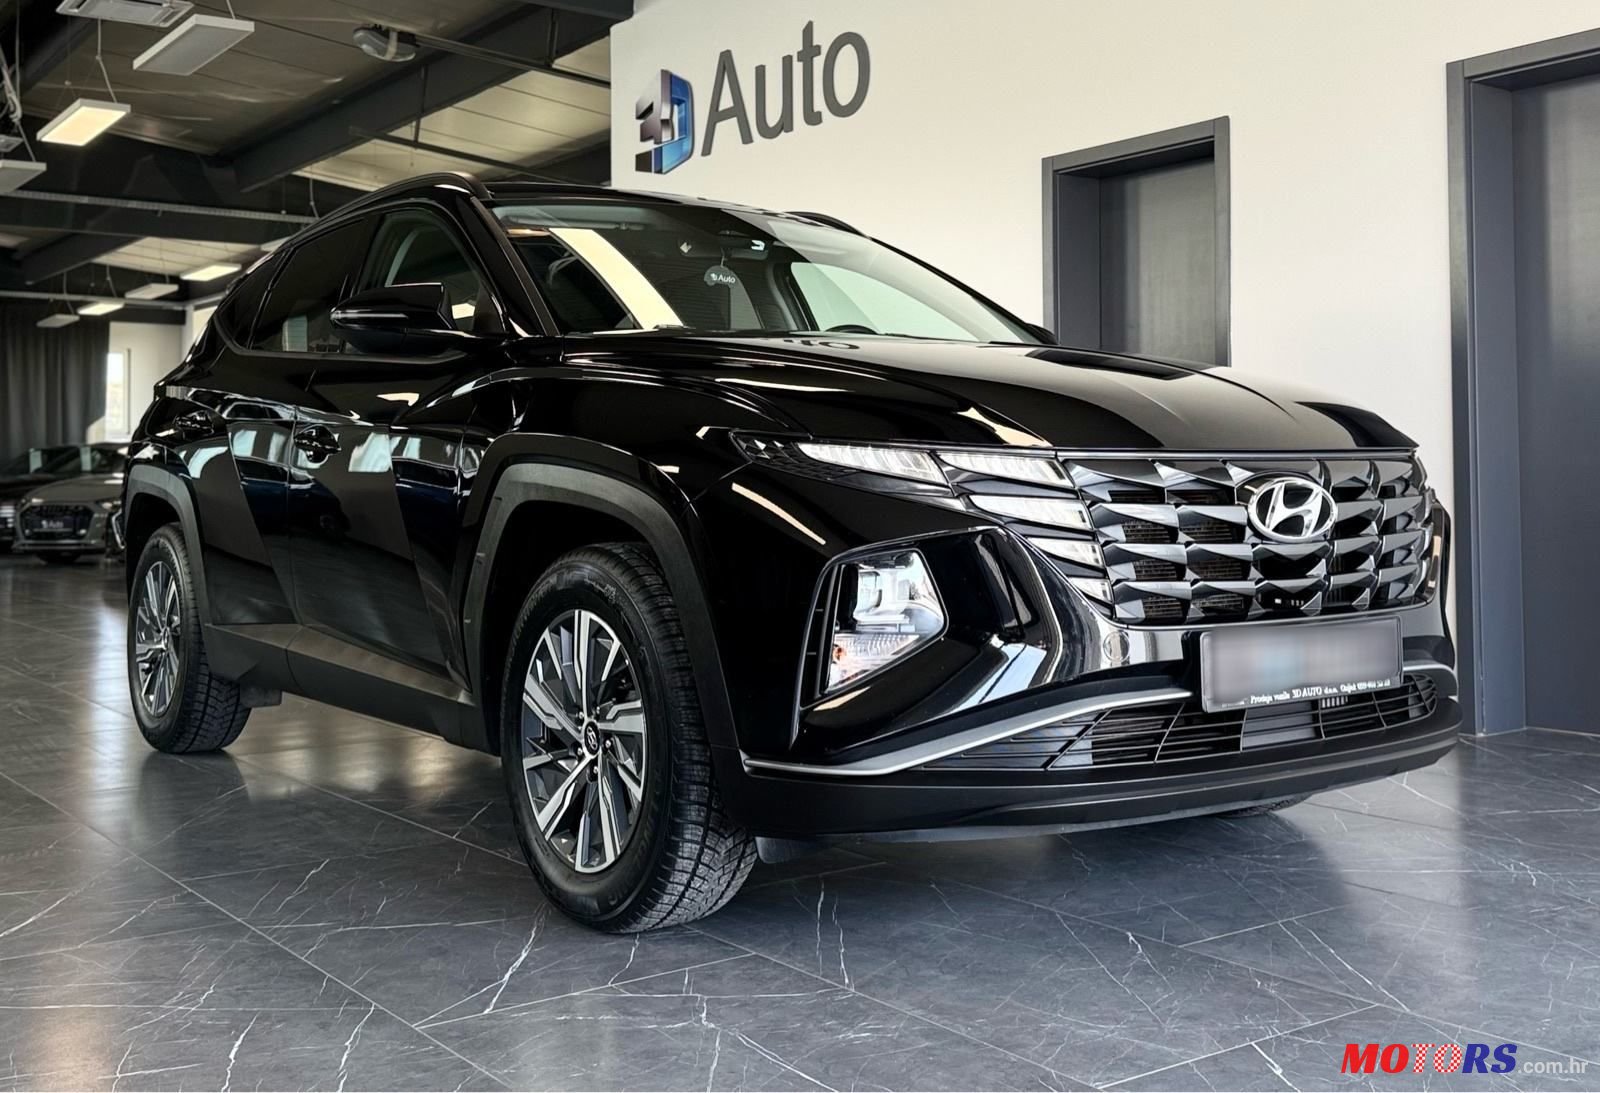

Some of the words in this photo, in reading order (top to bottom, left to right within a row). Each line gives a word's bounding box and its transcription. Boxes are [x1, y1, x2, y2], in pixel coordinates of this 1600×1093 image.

[701, 20, 871, 157] Auto
[718, 274, 736, 284] Auto
[1302, 686, 1322, 698] AUTO
